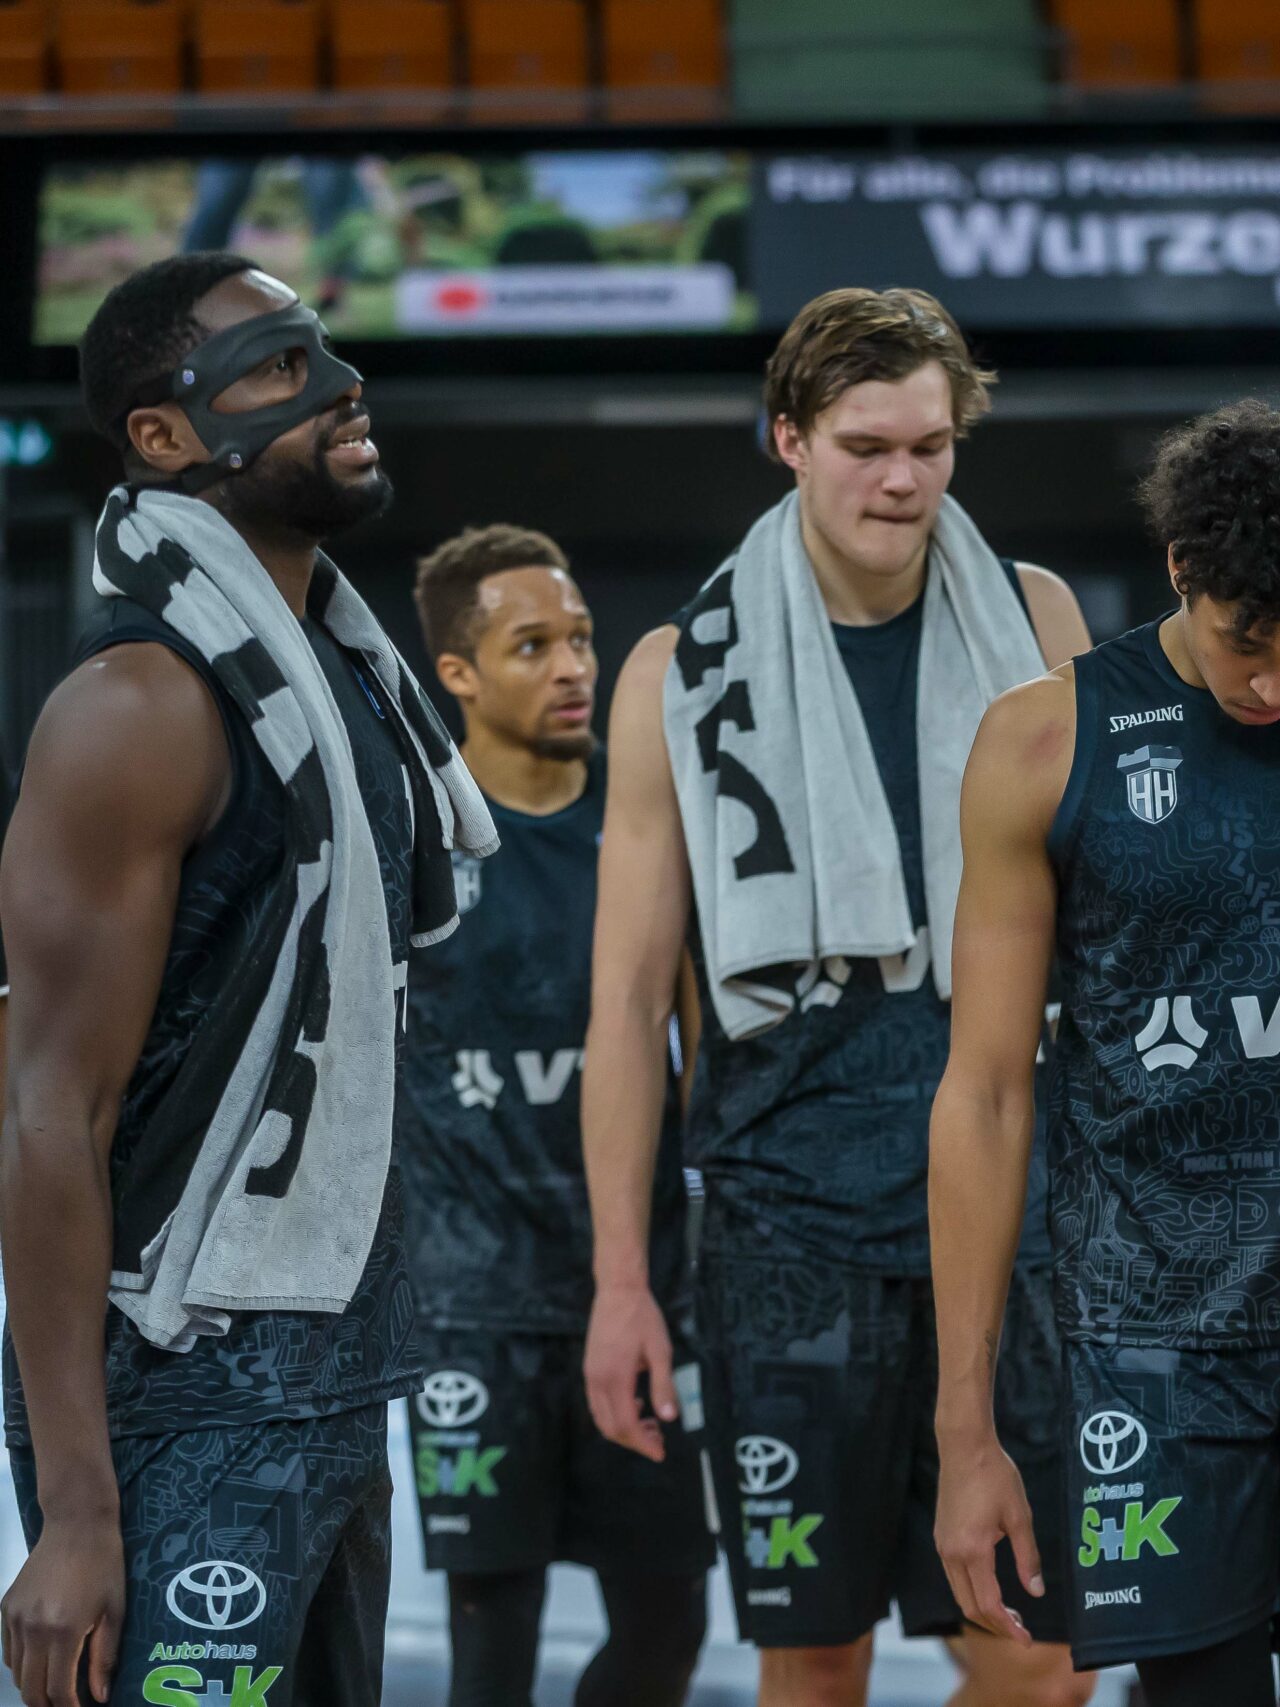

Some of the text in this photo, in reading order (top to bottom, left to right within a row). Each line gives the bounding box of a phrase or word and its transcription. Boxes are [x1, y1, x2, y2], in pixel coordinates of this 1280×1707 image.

[1109, 704, 1184, 734] SPALDING
[1077, 1496, 1183, 1568] S+K
[1085, 1585, 1142, 1610] SPALDING
[148, 1641, 257, 1662] Autohaus
